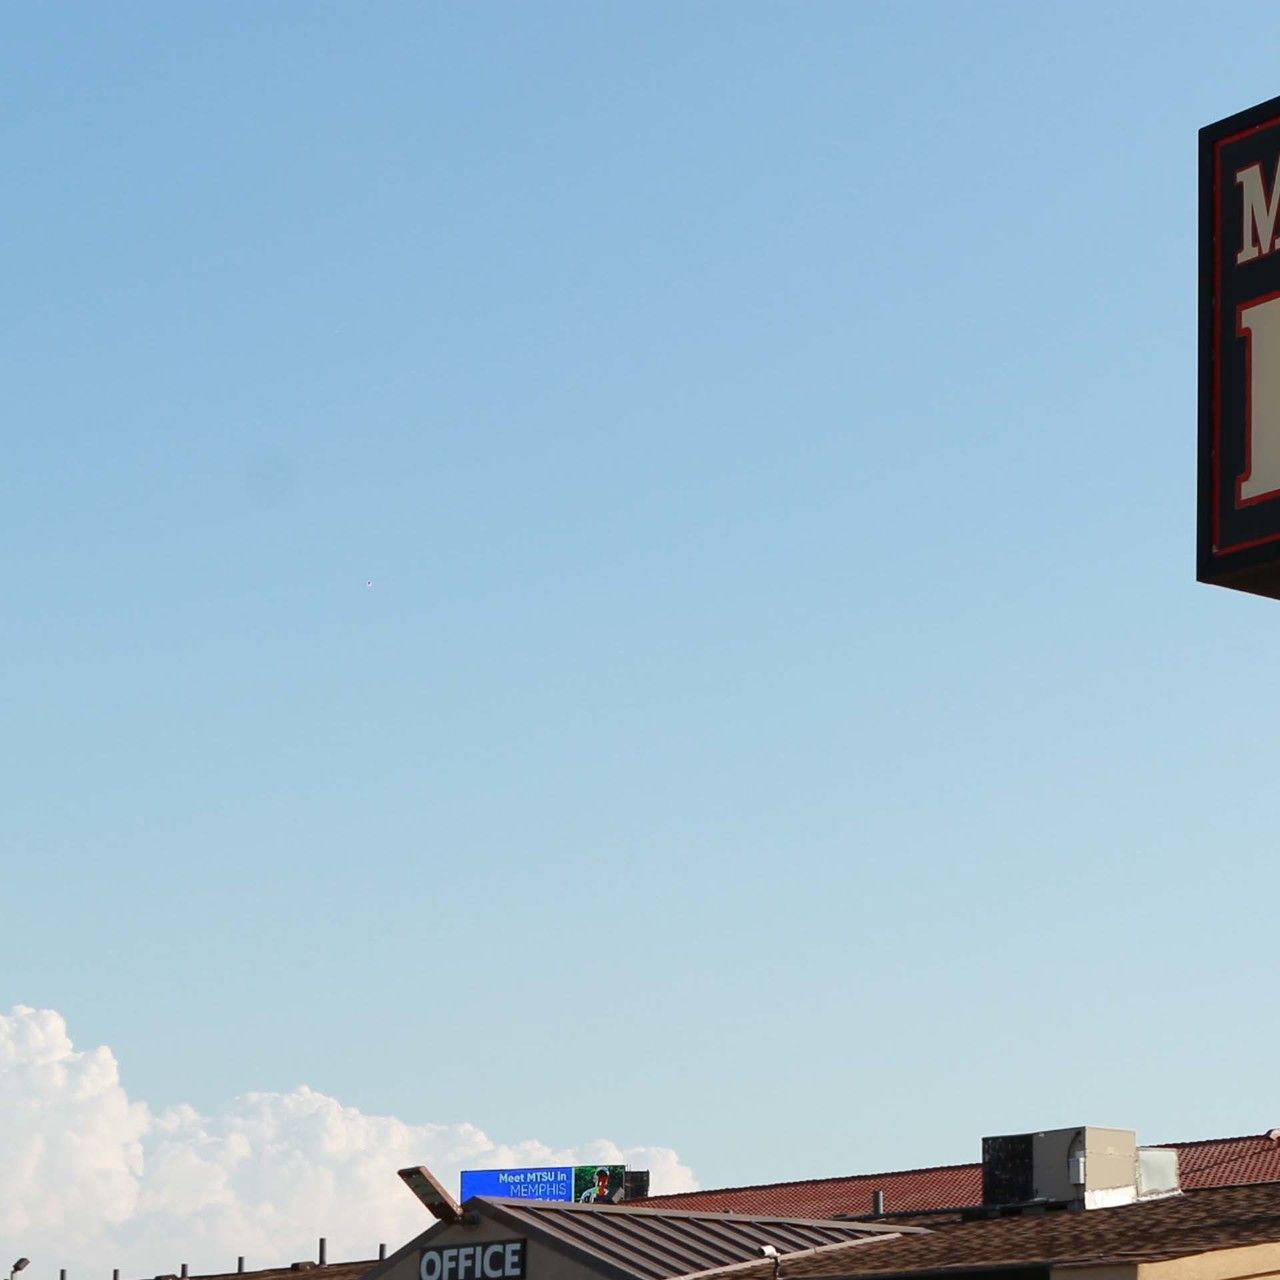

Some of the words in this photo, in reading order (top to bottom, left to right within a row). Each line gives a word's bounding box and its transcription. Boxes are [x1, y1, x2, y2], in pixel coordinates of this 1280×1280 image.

[499, 1173, 525, 1184] Meet
[527, 1171, 555, 1182] MTSU
[510, 1182, 567, 1197] MEMPHIS
